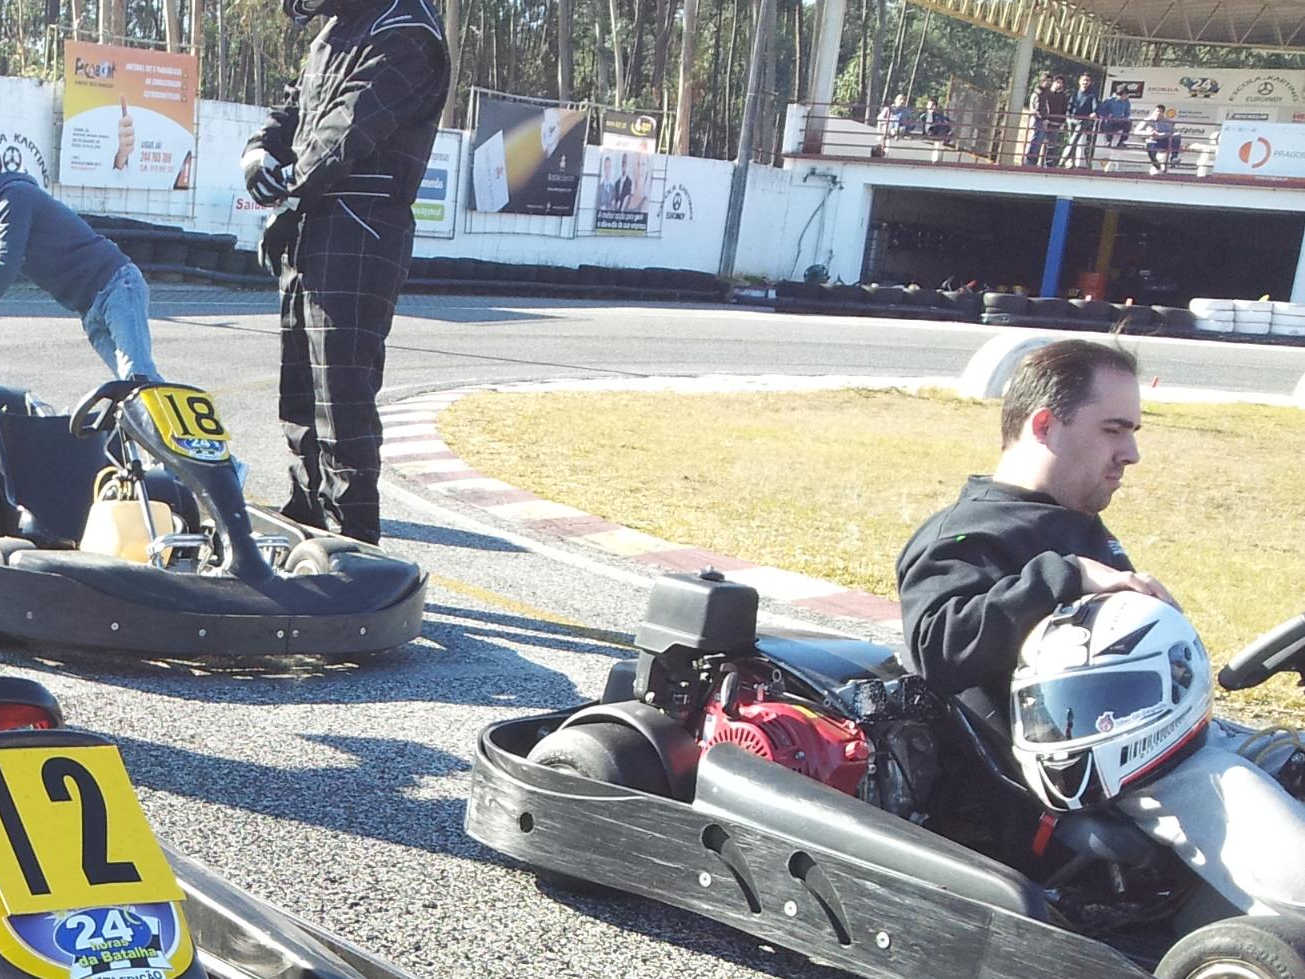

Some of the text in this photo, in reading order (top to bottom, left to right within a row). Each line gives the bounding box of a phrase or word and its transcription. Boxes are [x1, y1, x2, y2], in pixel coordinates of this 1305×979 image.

[164, 395, 225, 437] 18
[65, 909, 134, 950] 24
[78, 946, 158, 967] da Batalha
